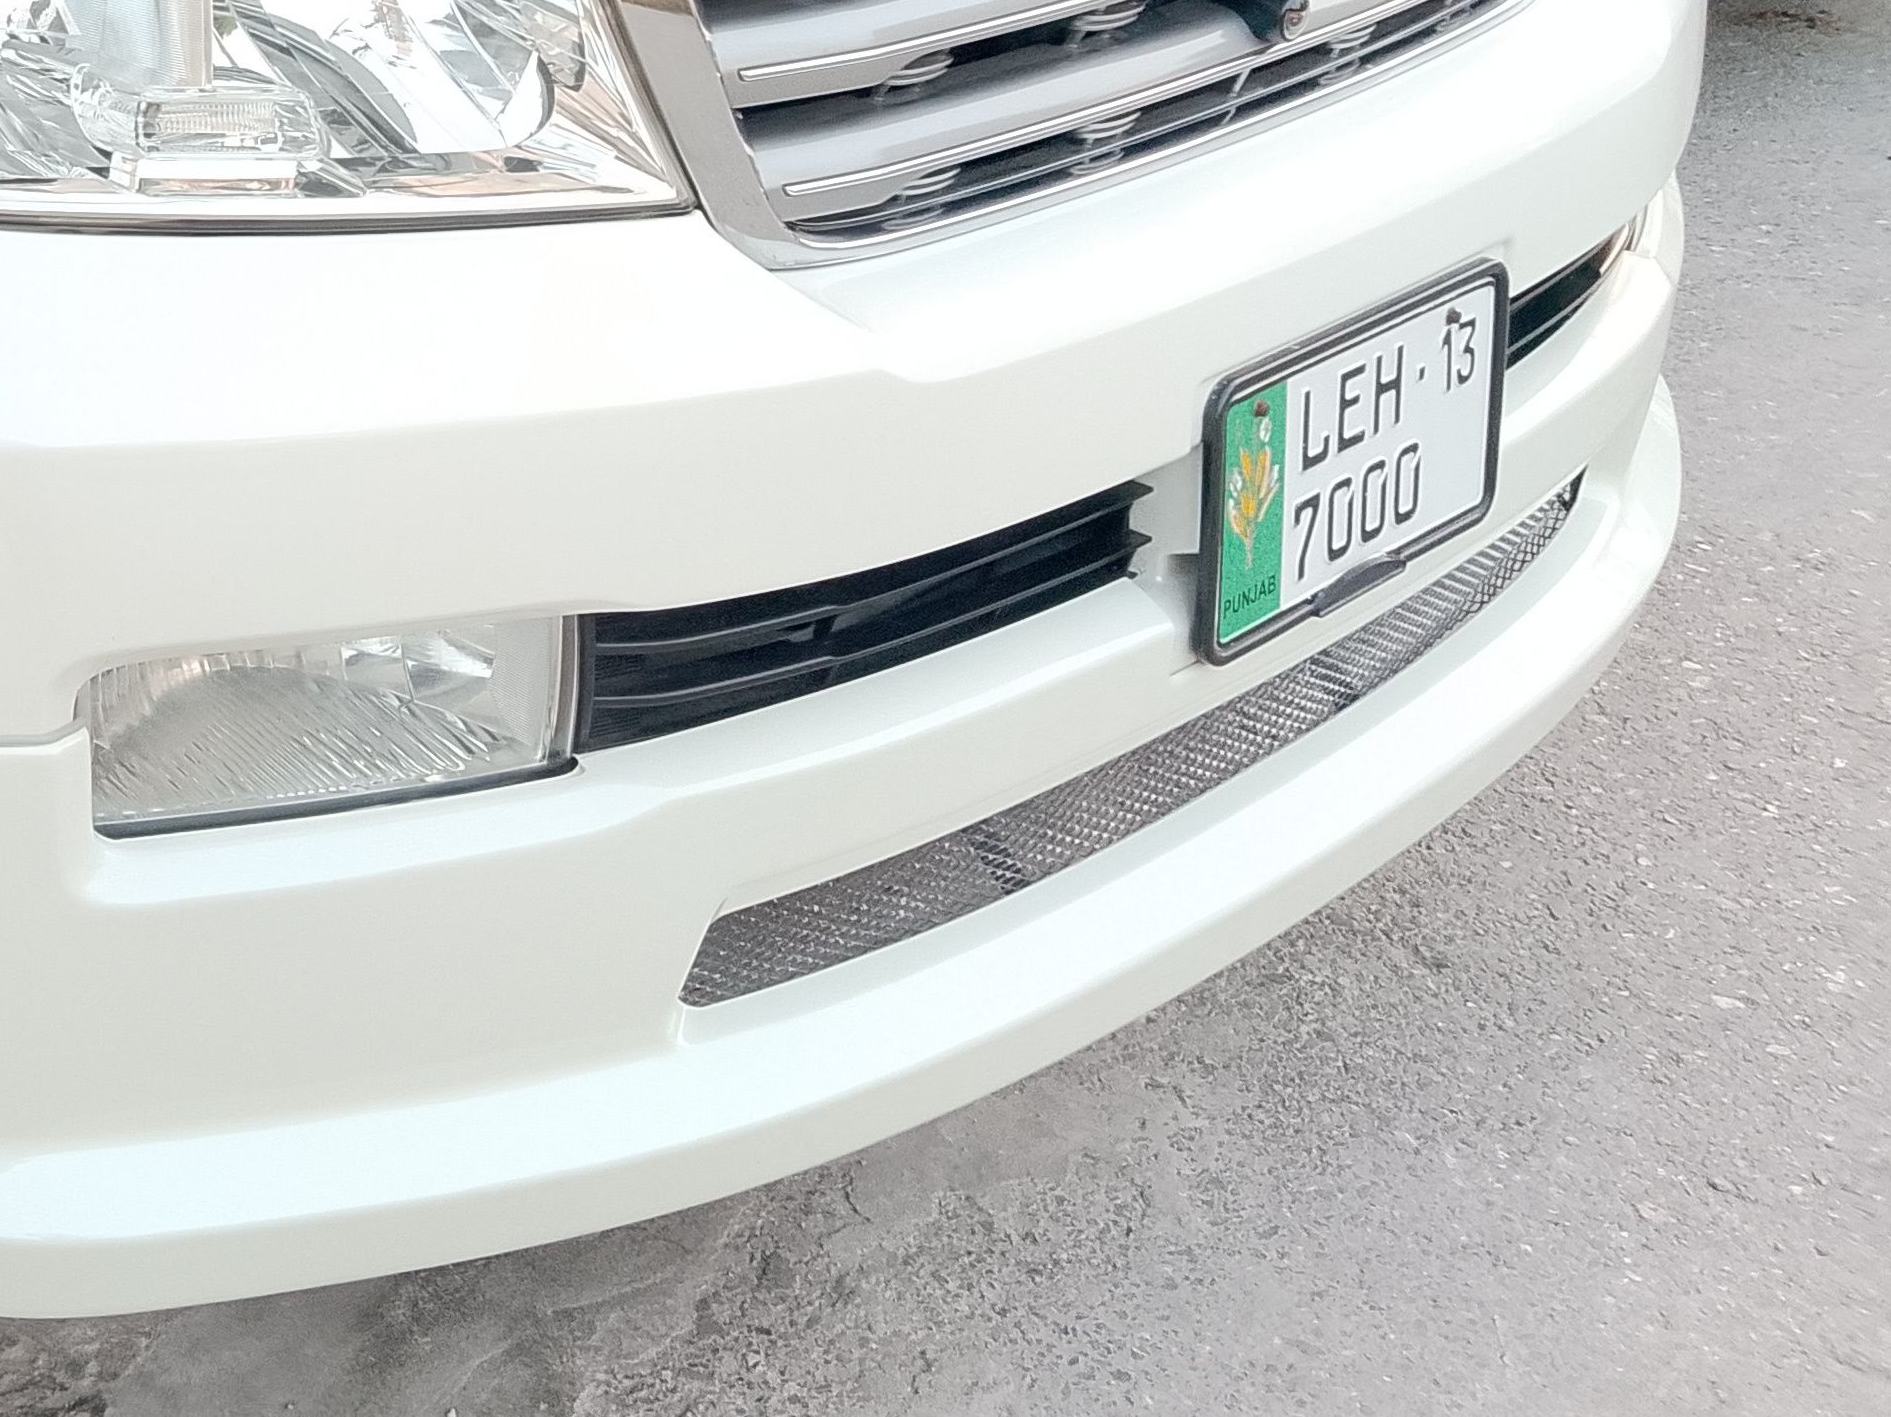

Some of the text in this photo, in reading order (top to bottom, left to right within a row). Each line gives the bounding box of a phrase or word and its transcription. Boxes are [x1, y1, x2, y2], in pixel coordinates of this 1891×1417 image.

[1301, 316, 1477, 472] LEH 13
[1293, 440, 1422, 583] 7000
[1223, 574, 1277, 620] PUNJAB
